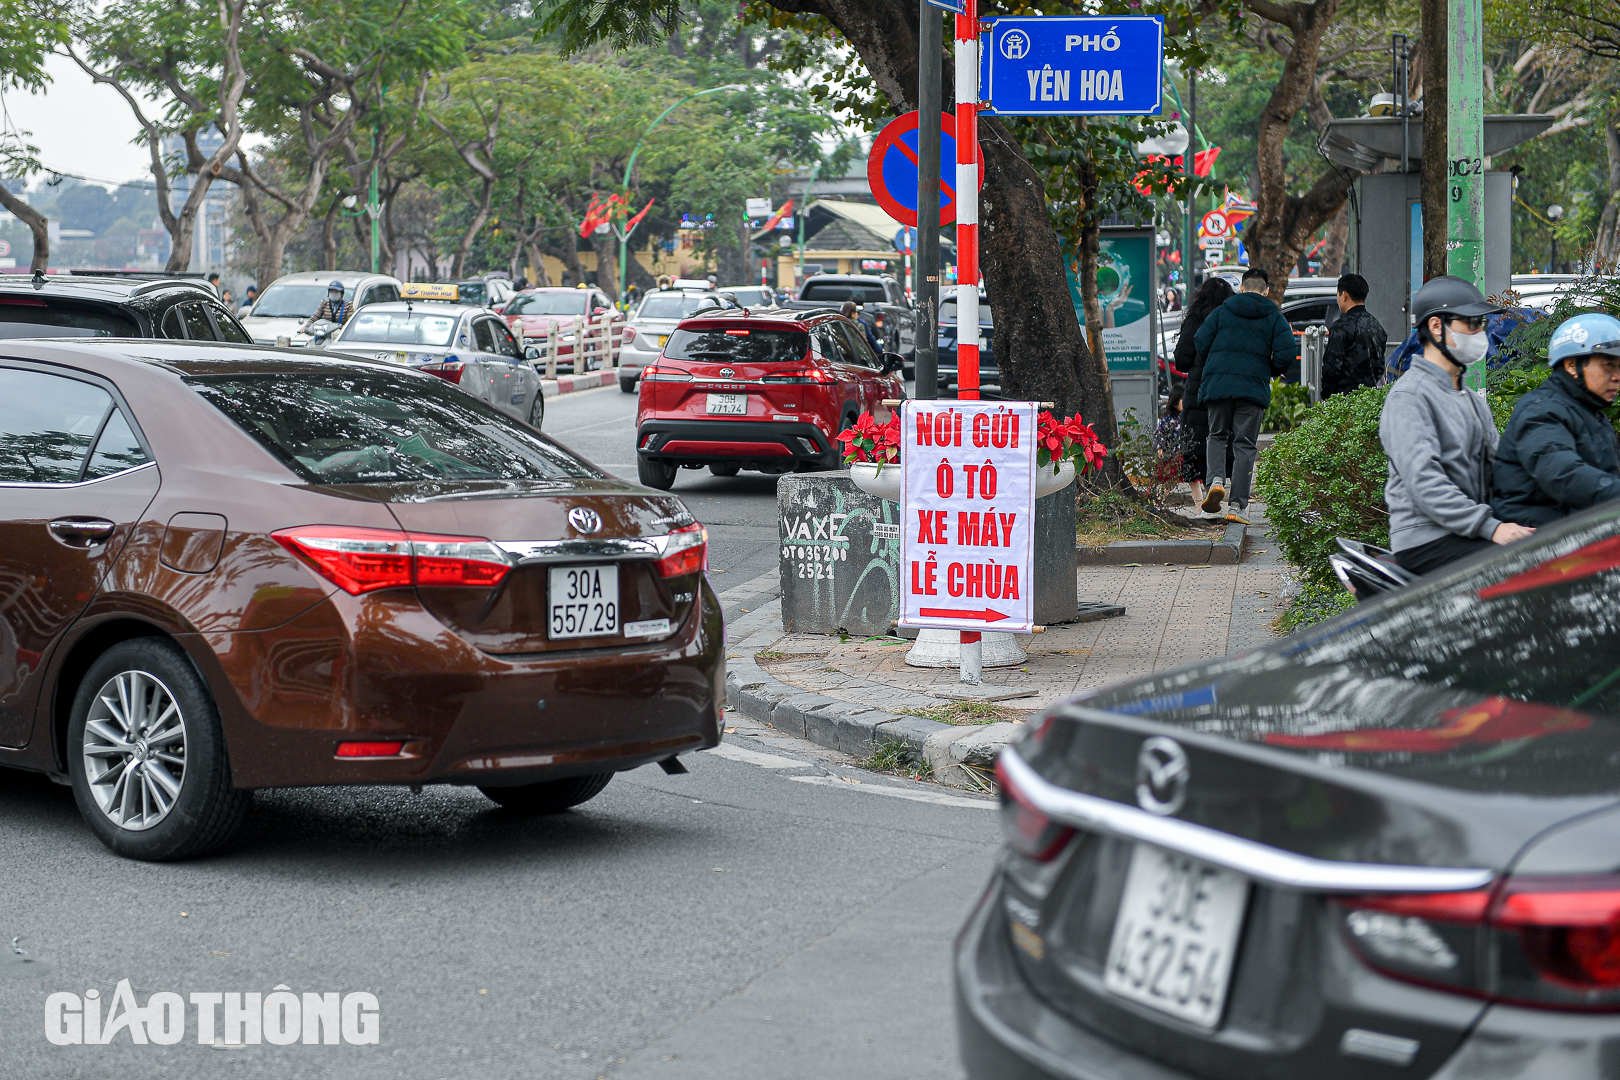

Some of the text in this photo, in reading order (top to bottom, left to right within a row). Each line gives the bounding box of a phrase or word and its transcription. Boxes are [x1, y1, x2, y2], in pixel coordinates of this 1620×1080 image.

[1065, 26, 1121, 52] PHỐ
[1027, 63, 1124, 101] YÊN HOA
[711, 403, 742, 413] 771.74
[718, 394, 736, 404] 30H
[916, 405, 1020, 449] NƠI GỬI
[936, 457, 997, 500] Ô TÔ
[917, 506, 1017, 547] XE MÁY
[567, 568, 603, 599] 30A
[798, 562, 835, 580] 2521
[911, 550, 1020, 600] LỄ CHÙA
[552, 601, 616, 635] 557.29
